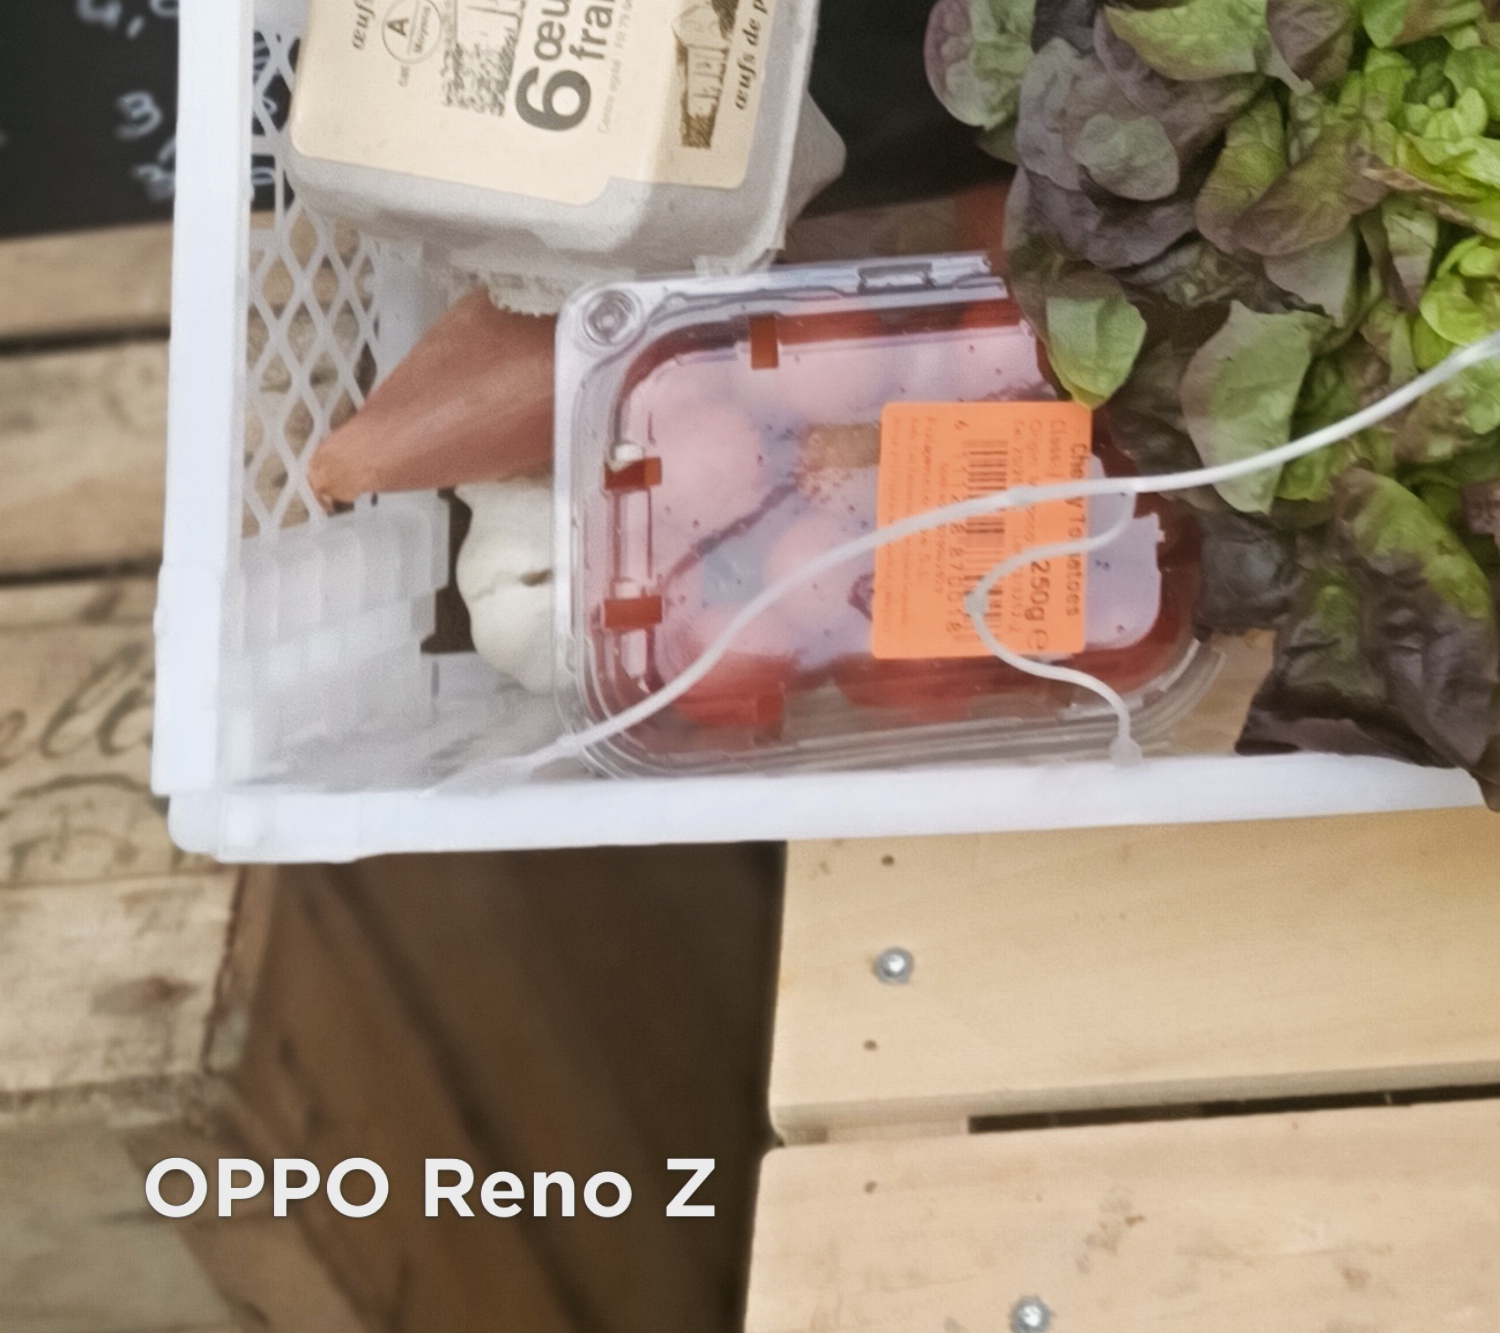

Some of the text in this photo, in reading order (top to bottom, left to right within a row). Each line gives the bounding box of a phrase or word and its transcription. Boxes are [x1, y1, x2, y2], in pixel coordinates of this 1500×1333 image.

[387, 17, 409, 38] A
[741, 18, 761, 47] de
[515, 67, 591, 132] 6
[1064, 443, 1087, 616] Chey Toatoes
[1026, 559, 1050, 621] 250g
